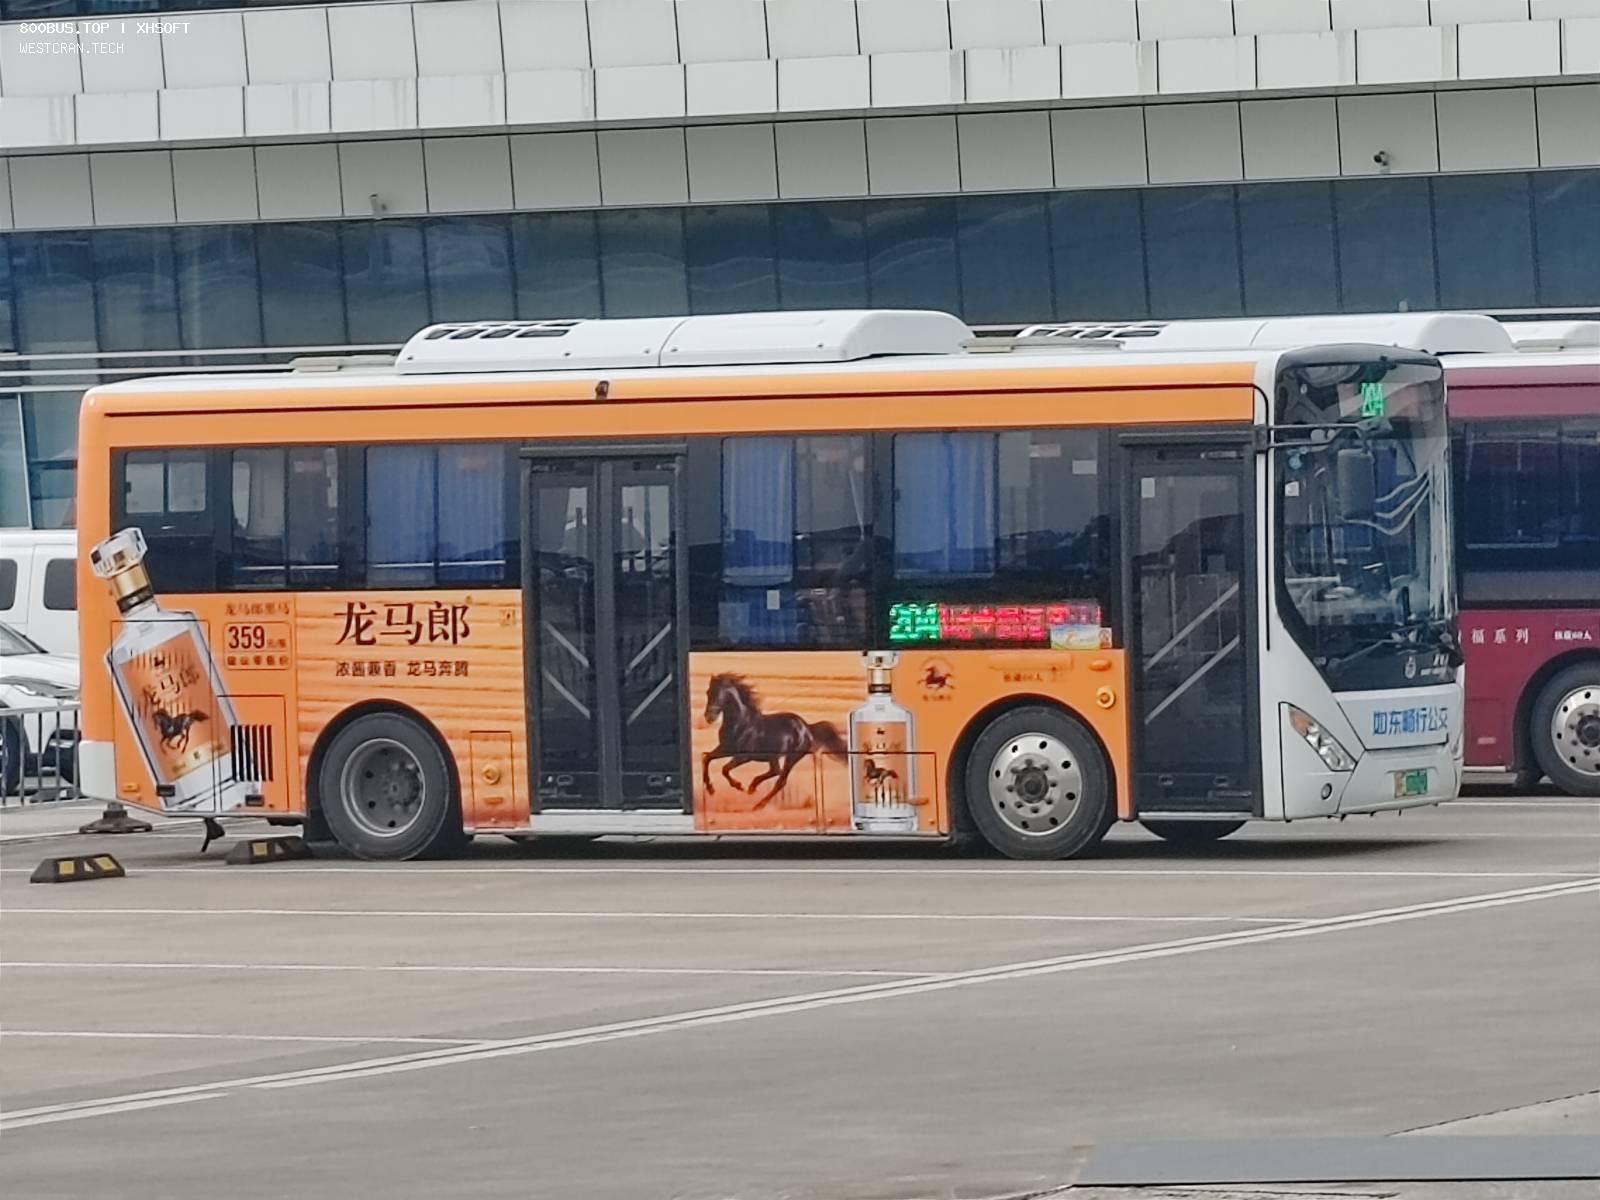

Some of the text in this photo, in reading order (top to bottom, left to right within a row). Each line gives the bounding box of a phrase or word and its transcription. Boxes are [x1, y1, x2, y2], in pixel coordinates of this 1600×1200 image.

[228, 625, 266, 650] 359
[333, 600, 471, 646] 龙马郎
